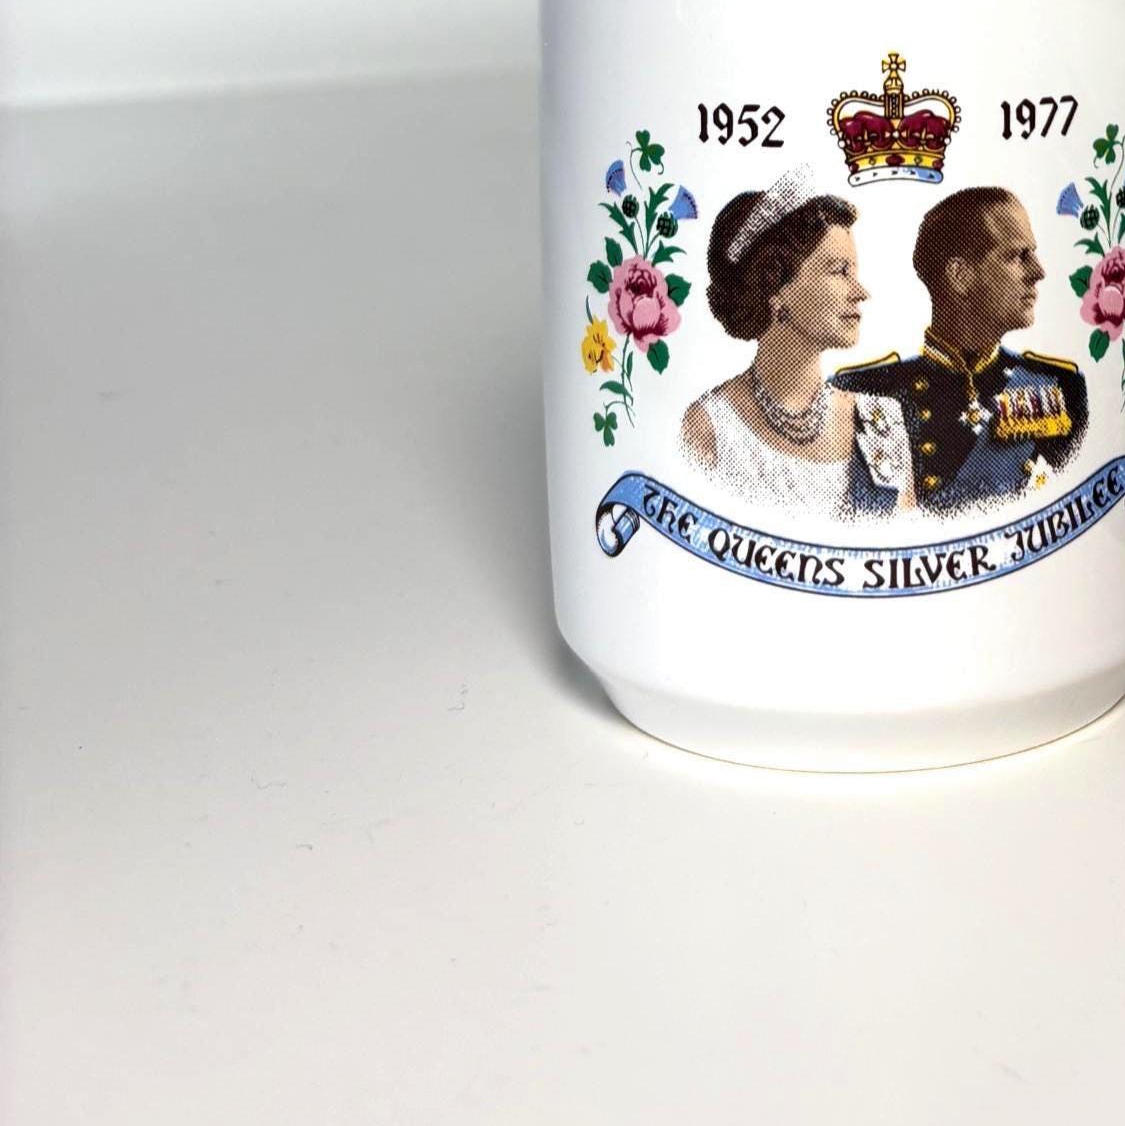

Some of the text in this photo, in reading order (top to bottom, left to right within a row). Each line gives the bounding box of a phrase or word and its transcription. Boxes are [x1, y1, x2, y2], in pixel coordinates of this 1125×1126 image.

[698, 103, 786, 149] 1952
[1000, 95, 1079, 140] 1977
[643, 466, 1125, 589] THE QUEENS SILVER JUBILEE
